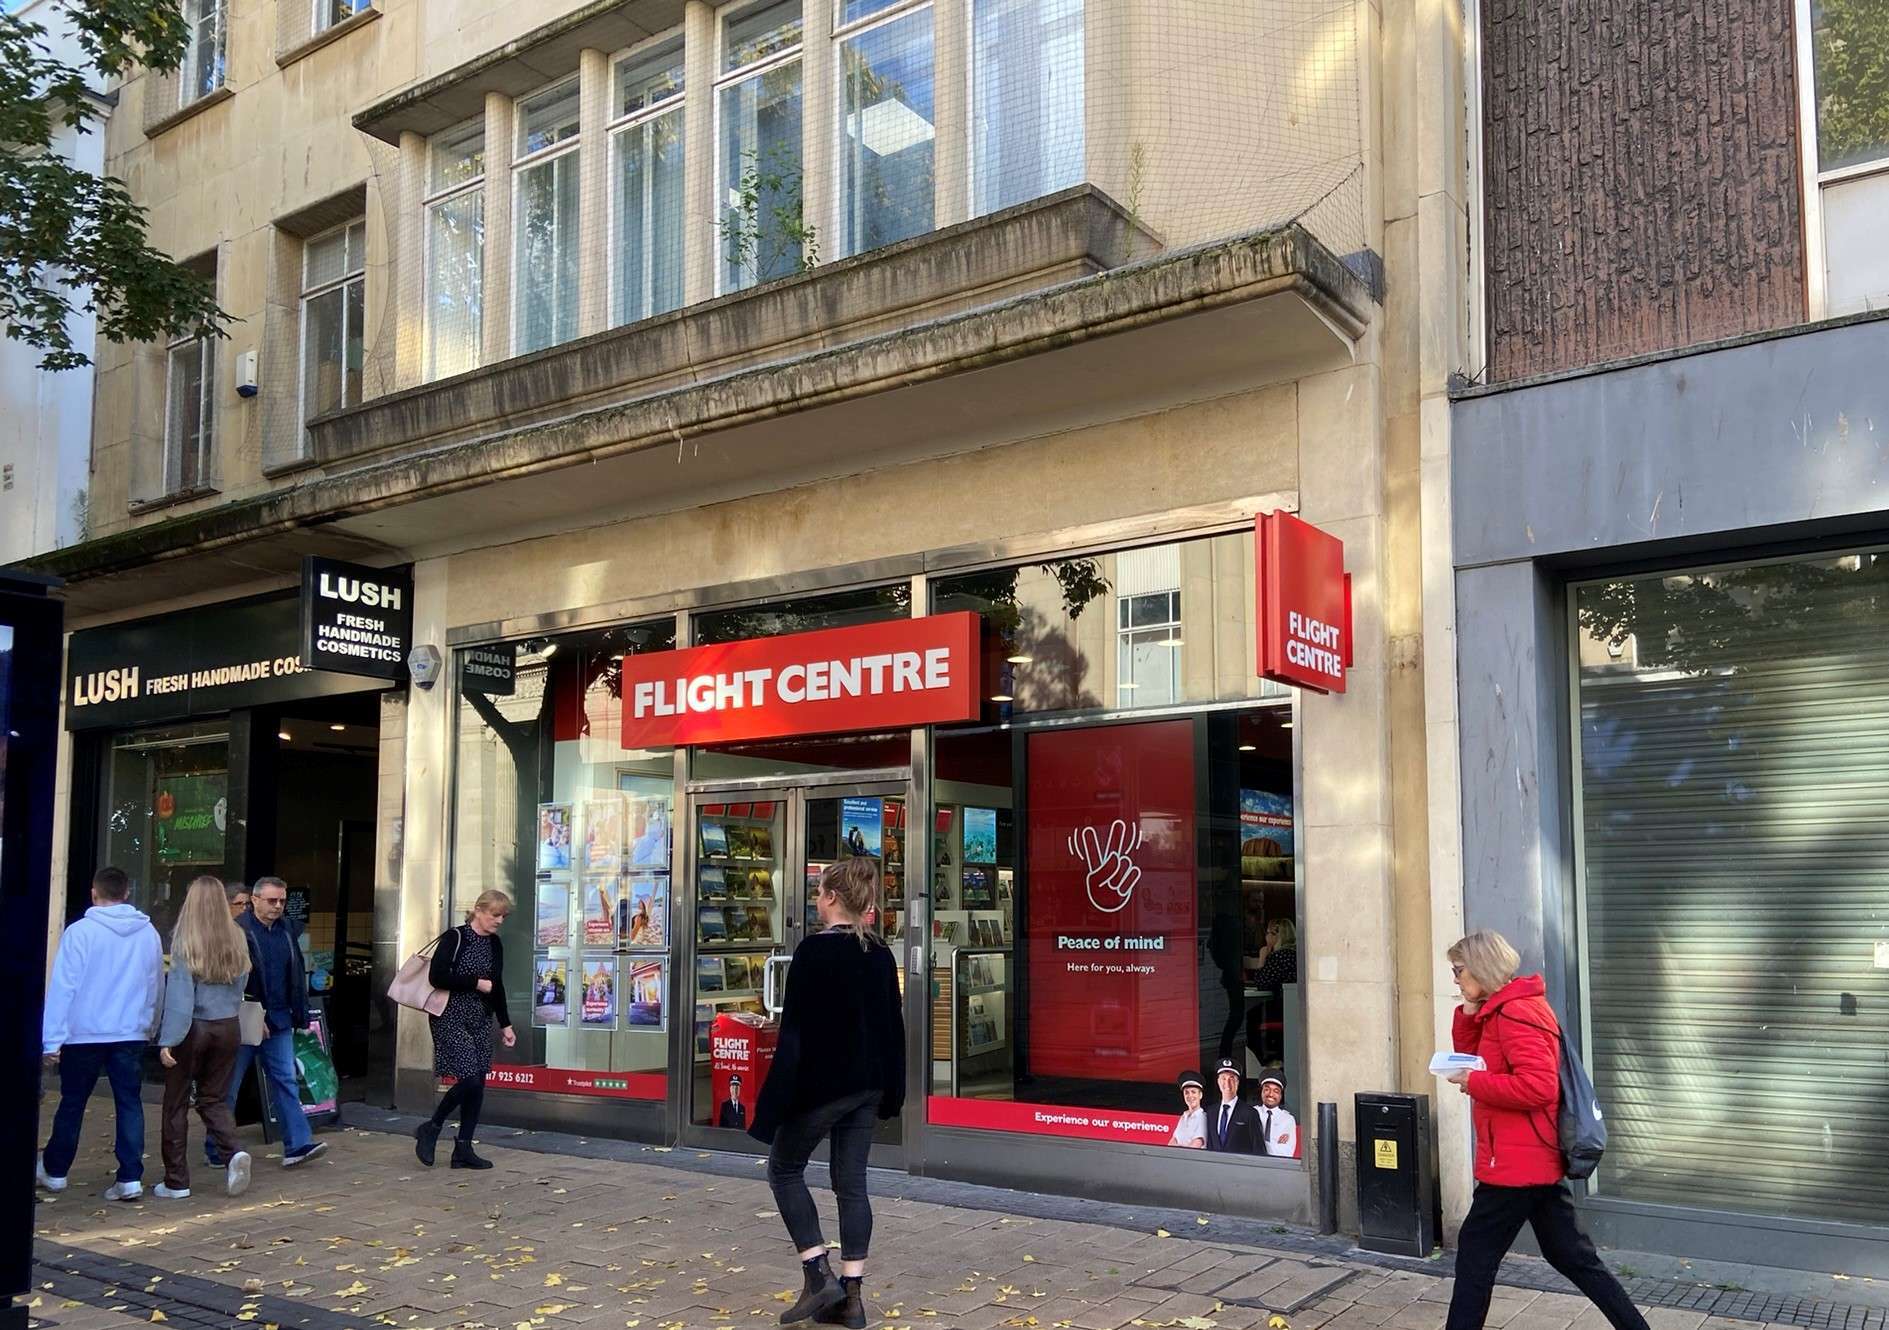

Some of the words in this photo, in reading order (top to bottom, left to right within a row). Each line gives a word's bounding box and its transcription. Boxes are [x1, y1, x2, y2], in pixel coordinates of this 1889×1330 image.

[320, 573, 401, 610] LUSH
[337, 613, 384, 632] FRESH
[1289, 610, 1340, 650] FLIGHT
[318, 625, 401, 649] HANDMADE
[316, 639, 402, 663] COSMETICS
[1286, 639, 1342, 678] CENTRE
[73, 666, 139, 707] LUSH
[146, 673, 188, 695] FRESH
[191, 659, 270, 689] HANDMADE
[633, 668, 772, 719] FLIGHT
[776, 647, 950, 704] CENTRE
[1058, 936, 1100, 949] Peace
[1104, 936, 1120, 949] of
[1124, 936, 1165, 949] mind
[1067, 962, 1089, 972] Here
[1091, 963, 1103, 972] for
[1106, 964, 1124, 974] you,
[1126, 964, 1155, 974] always
[713, 1038, 749, 1050] FLIGHT
[713, 1049, 751, 1061] CENTRE
[498, 1071, 513, 1082] 925
[515, 1073, 534, 1084] 6212
[1034, 1111, 1089, 1126] Experience
[1092, 1118, 1109, 1127] our
[1112, 1119, 1169, 1133] experience
